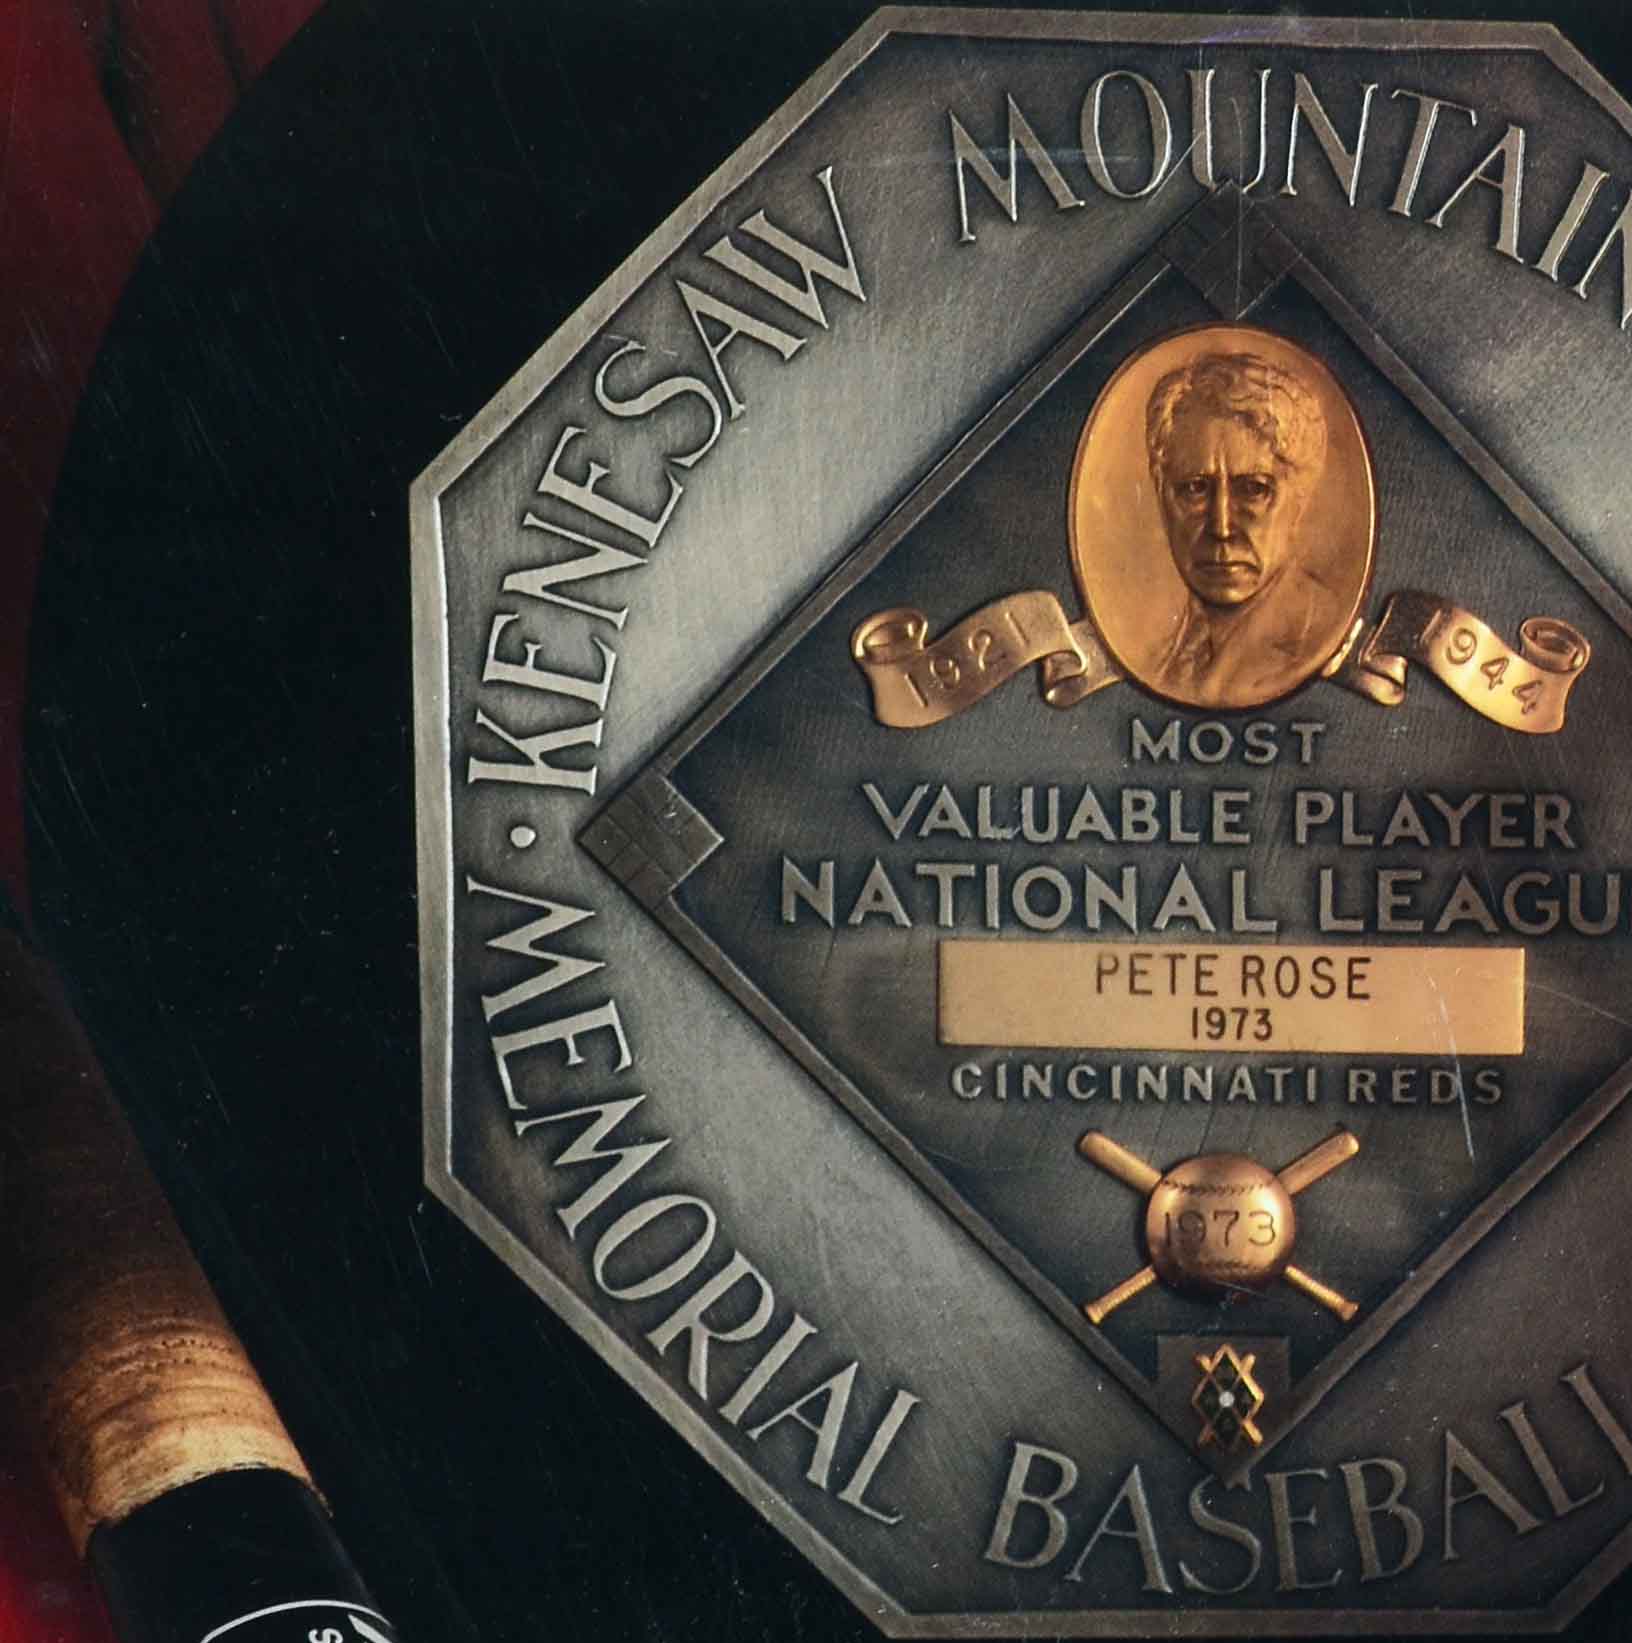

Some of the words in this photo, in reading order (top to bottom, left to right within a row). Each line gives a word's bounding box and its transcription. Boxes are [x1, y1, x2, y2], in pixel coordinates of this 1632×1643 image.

[467, 166, 866, 797] KENESAW
[901, 612, 1037, 710] 1921
[1440, 626, 1543, 716] 944
[1131, 717, 1327, 765] MOST
[864, 782, 1251, 845] VALUABLE
[1296, 791, 1577, 849] PLAYER
[782, 858, 1277, 934] NATIONAL
[1096, 952, 1222, 998] PETE
[1242, 955, 1373, 1000] ROSE
[1191, 1006, 1273, 1041] 1973
[952, 1061, 1317, 1104] CINCINNATI
[1347, 1066, 1504, 1105] REDS
[466, 873, 920, 1526] MEMORIAL
[1163, 1208, 1276, 1249] 1973
